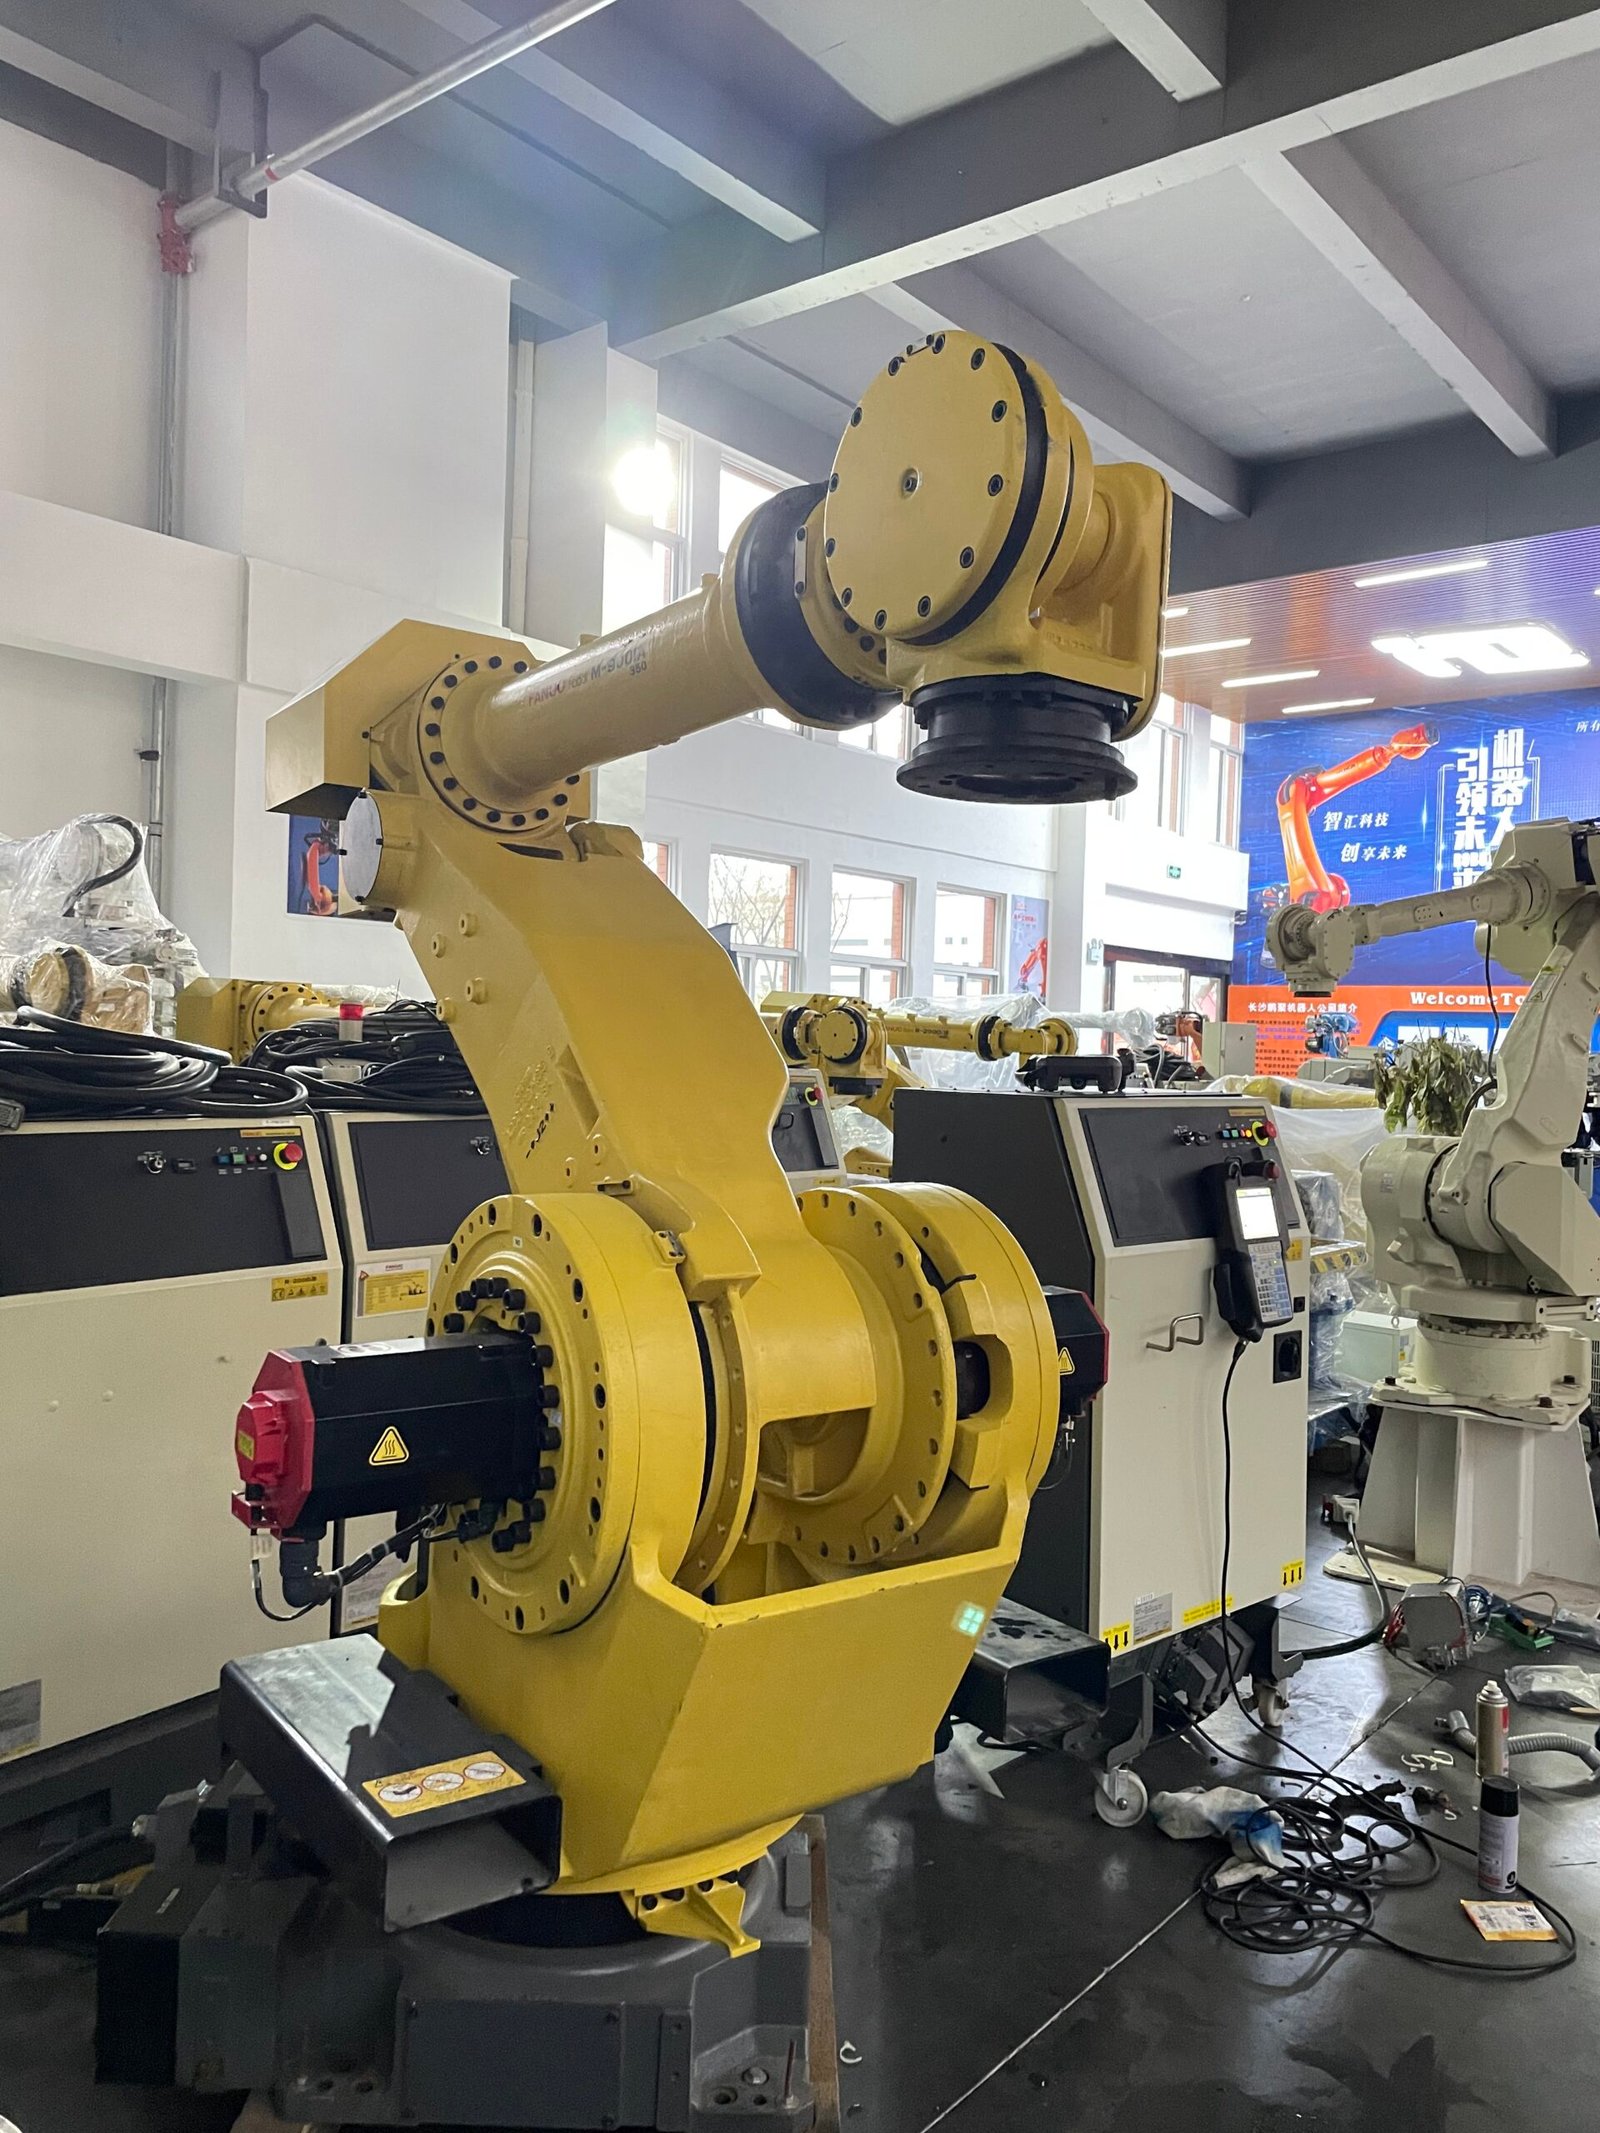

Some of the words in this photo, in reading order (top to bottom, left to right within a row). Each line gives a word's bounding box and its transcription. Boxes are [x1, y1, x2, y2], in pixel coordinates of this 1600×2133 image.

[1323, 811, 1389, 832] 智汇科技
[1341, 842, 1407, 863] 创享未来
[1410, 991, 1498, 1006] Welcome
